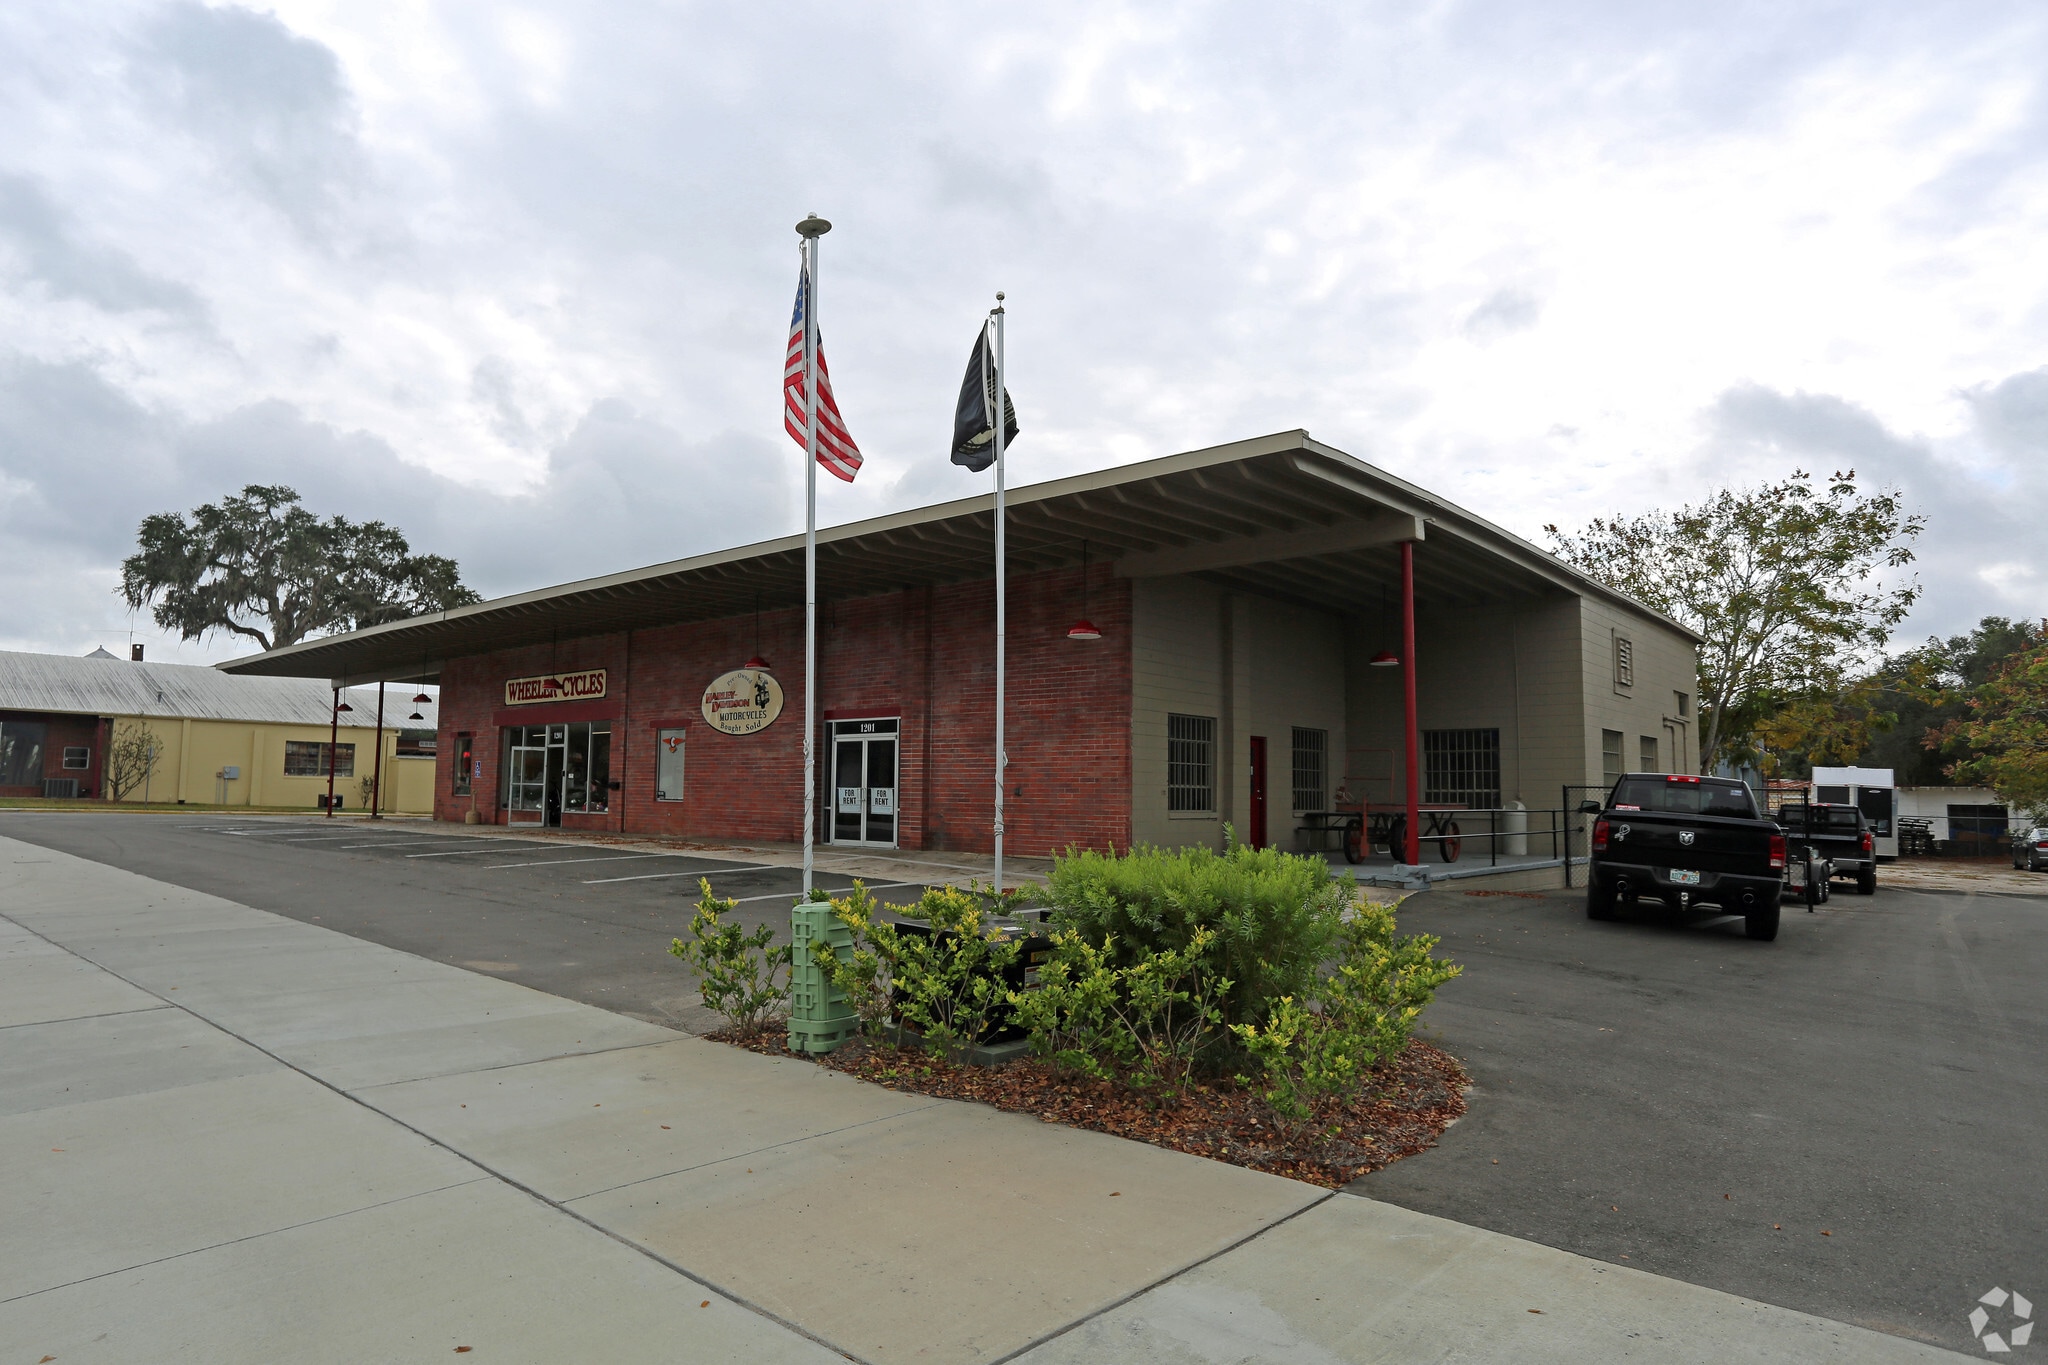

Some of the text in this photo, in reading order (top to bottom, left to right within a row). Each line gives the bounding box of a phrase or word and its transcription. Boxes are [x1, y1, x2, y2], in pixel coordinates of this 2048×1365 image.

[562, 673, 604, 697] CYCLES
[720, 710, 766, 721] MOTORCYCLES
[720, 720, 761, 733] Bought Sold
[860, 723, 875, 733] 1201
[844, 789, 855, 797] FOR
[876, 789, 887, 798] FOR
[842, 797, 857, 805] RENT
[874, 798, 889, 806] RENT
